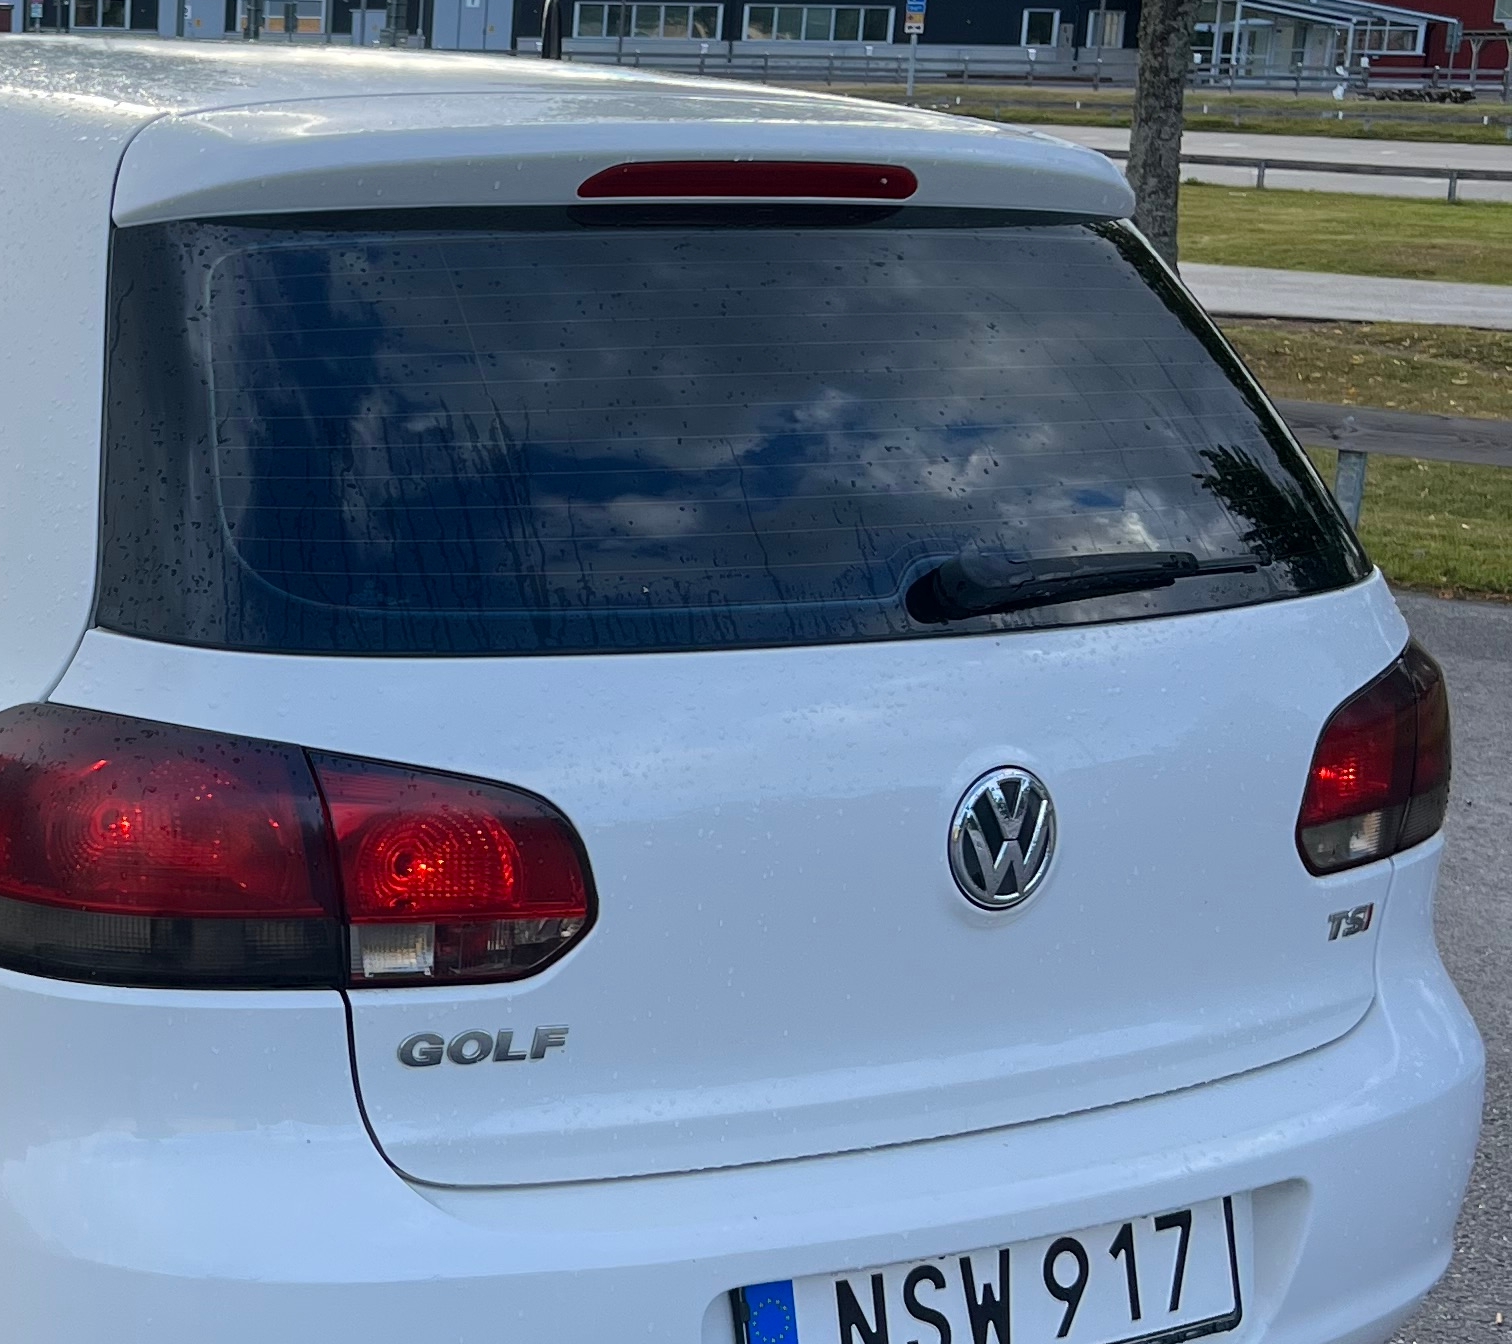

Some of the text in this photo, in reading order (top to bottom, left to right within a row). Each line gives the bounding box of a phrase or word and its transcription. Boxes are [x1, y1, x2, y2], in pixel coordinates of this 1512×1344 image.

[1327, 901, 1375, 942] TSI
[396, 1023, 569, 1067] GOLF
[1042, 1208, 1194, 1340] 917
